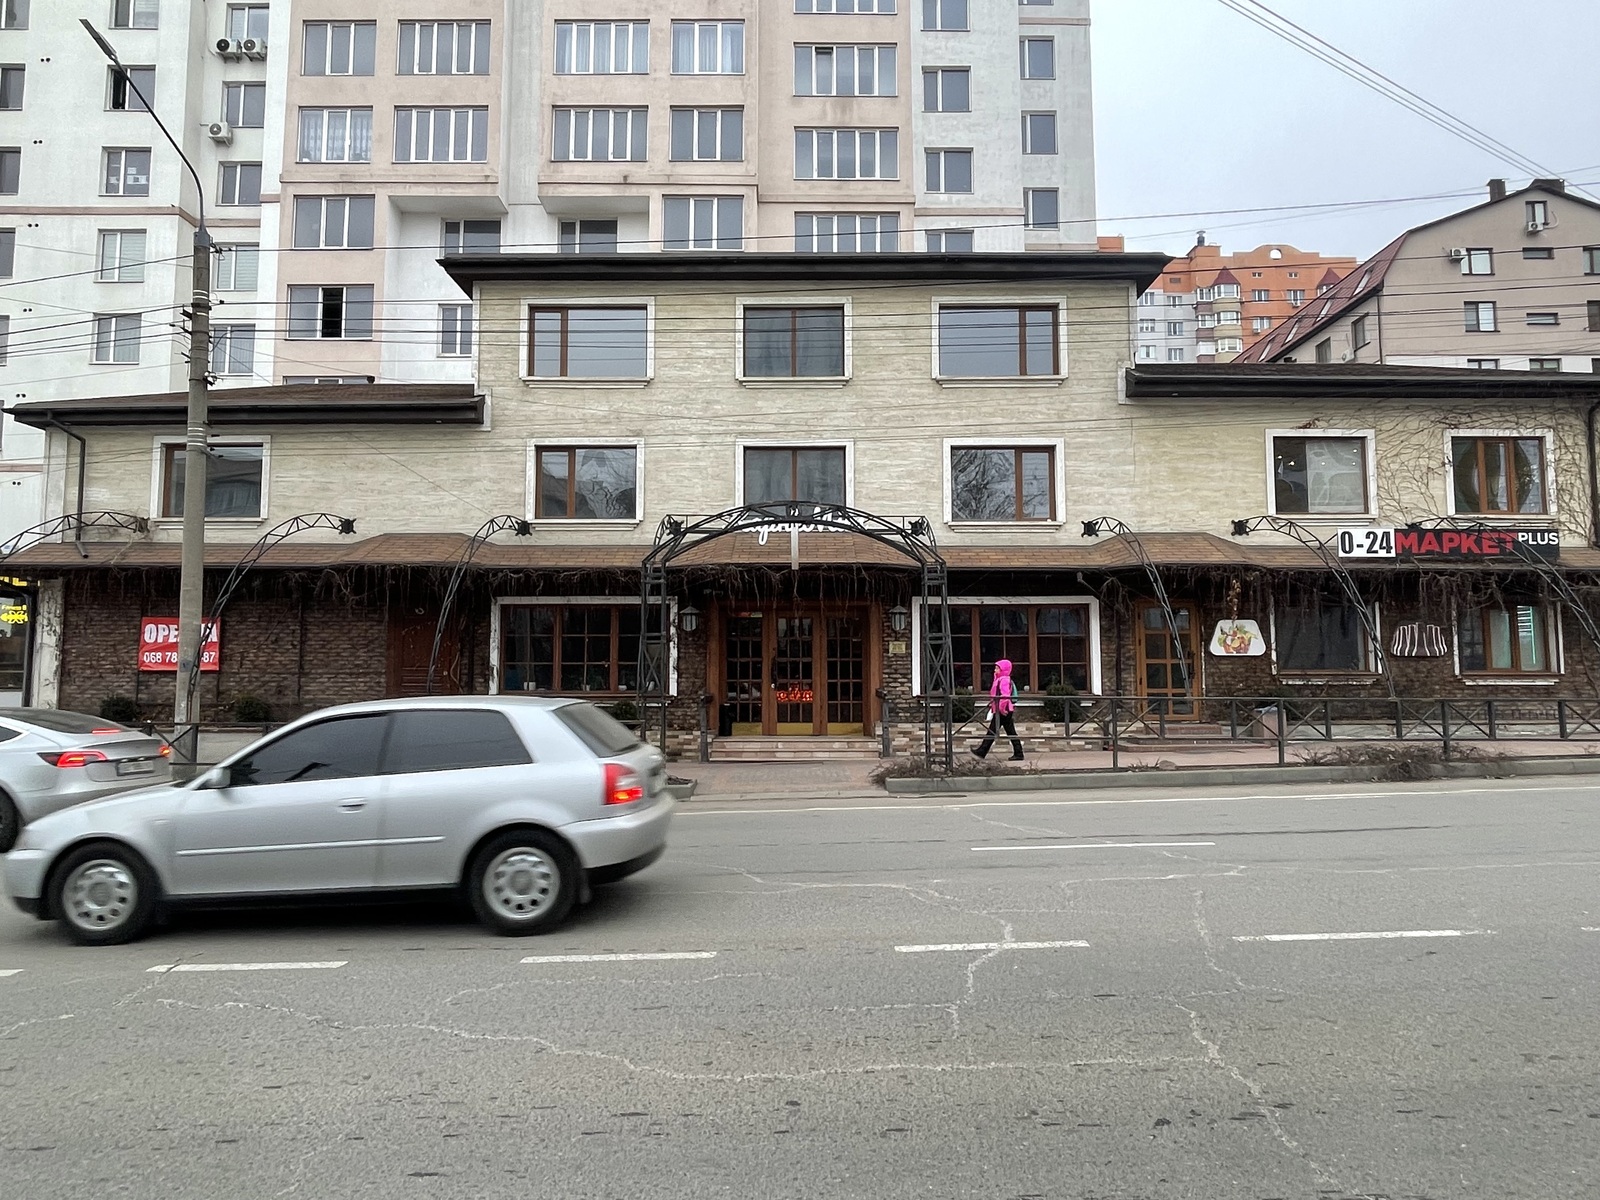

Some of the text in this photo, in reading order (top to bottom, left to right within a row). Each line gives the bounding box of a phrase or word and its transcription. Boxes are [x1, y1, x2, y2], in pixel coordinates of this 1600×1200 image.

[1340, 530, 1393, 555] 0-24
[1395, 531, 1559, 555] МАРКЕТ PLUS
[144, 623, 218, 645] ОРЕА
[143, 652, 163, 663] 068
